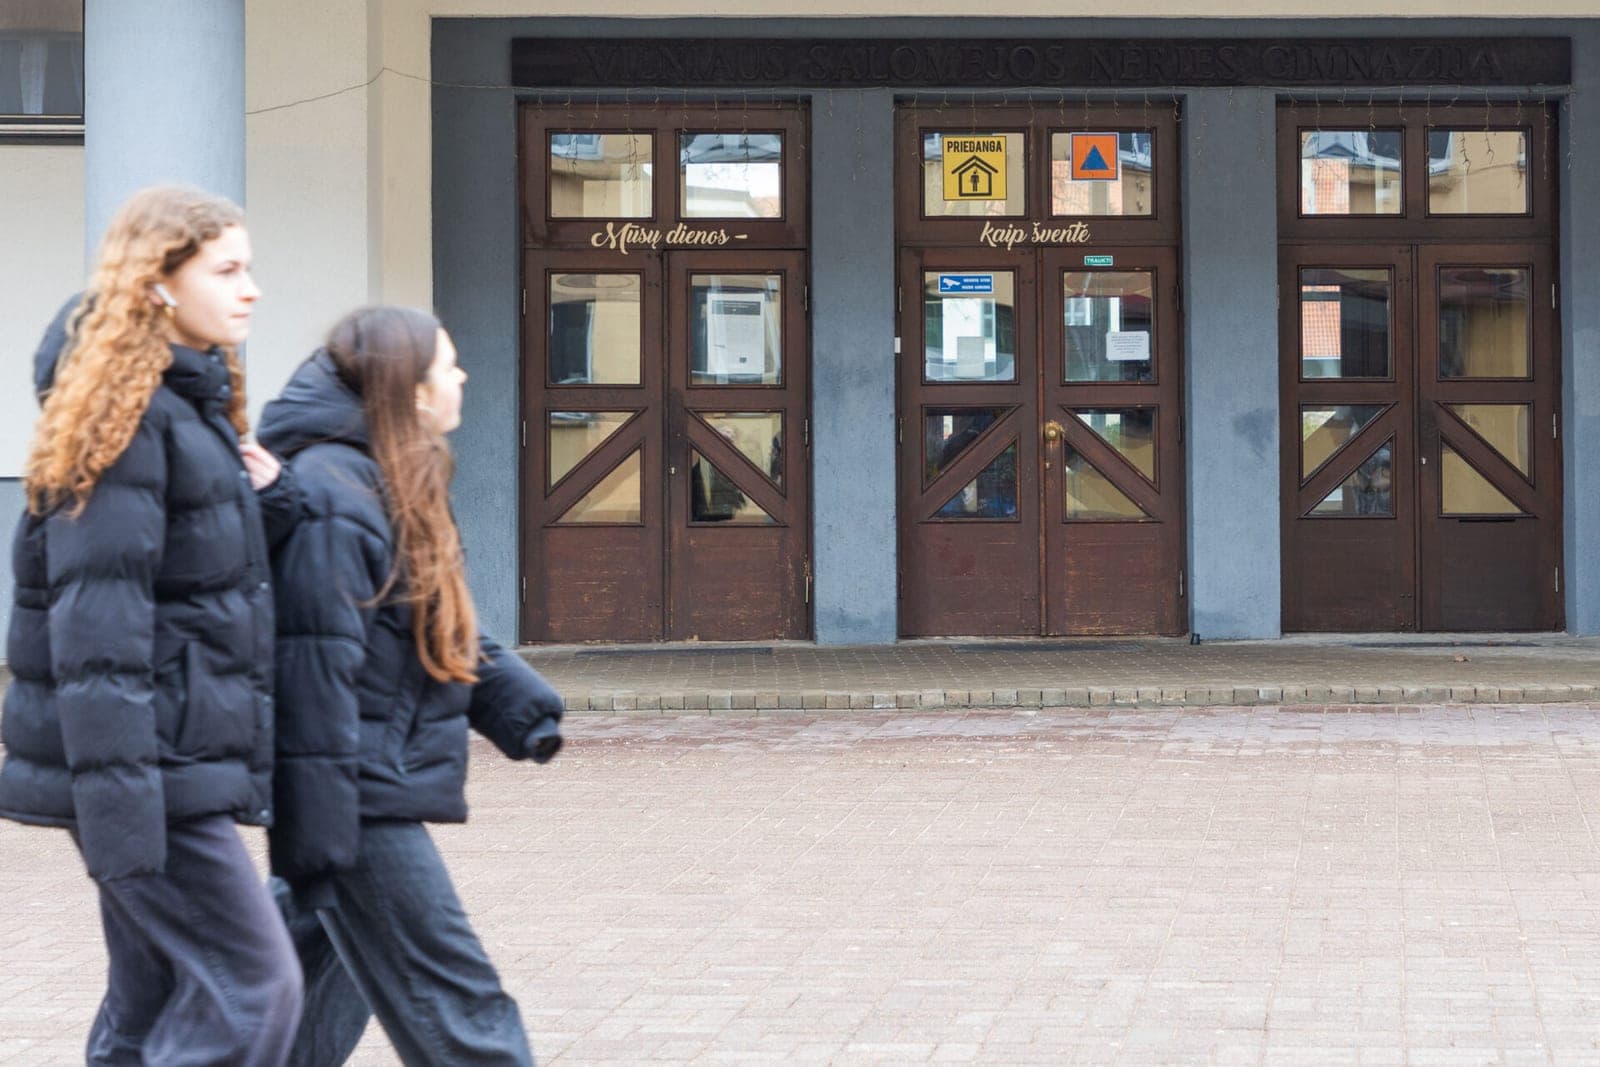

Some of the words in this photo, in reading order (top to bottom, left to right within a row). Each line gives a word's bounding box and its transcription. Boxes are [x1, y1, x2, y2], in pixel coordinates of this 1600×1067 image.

[584, 45, 786, 81] VILNIAUS
[1262, 45, 1503, 81] GIMNAZIJA
[946, 140, 1003, 153] PRIEDANGA
[591, 222, 661, 255] Mūsų
[666, 222, 730, 245] dienos
[979, 221, 1028, 250] kaip
